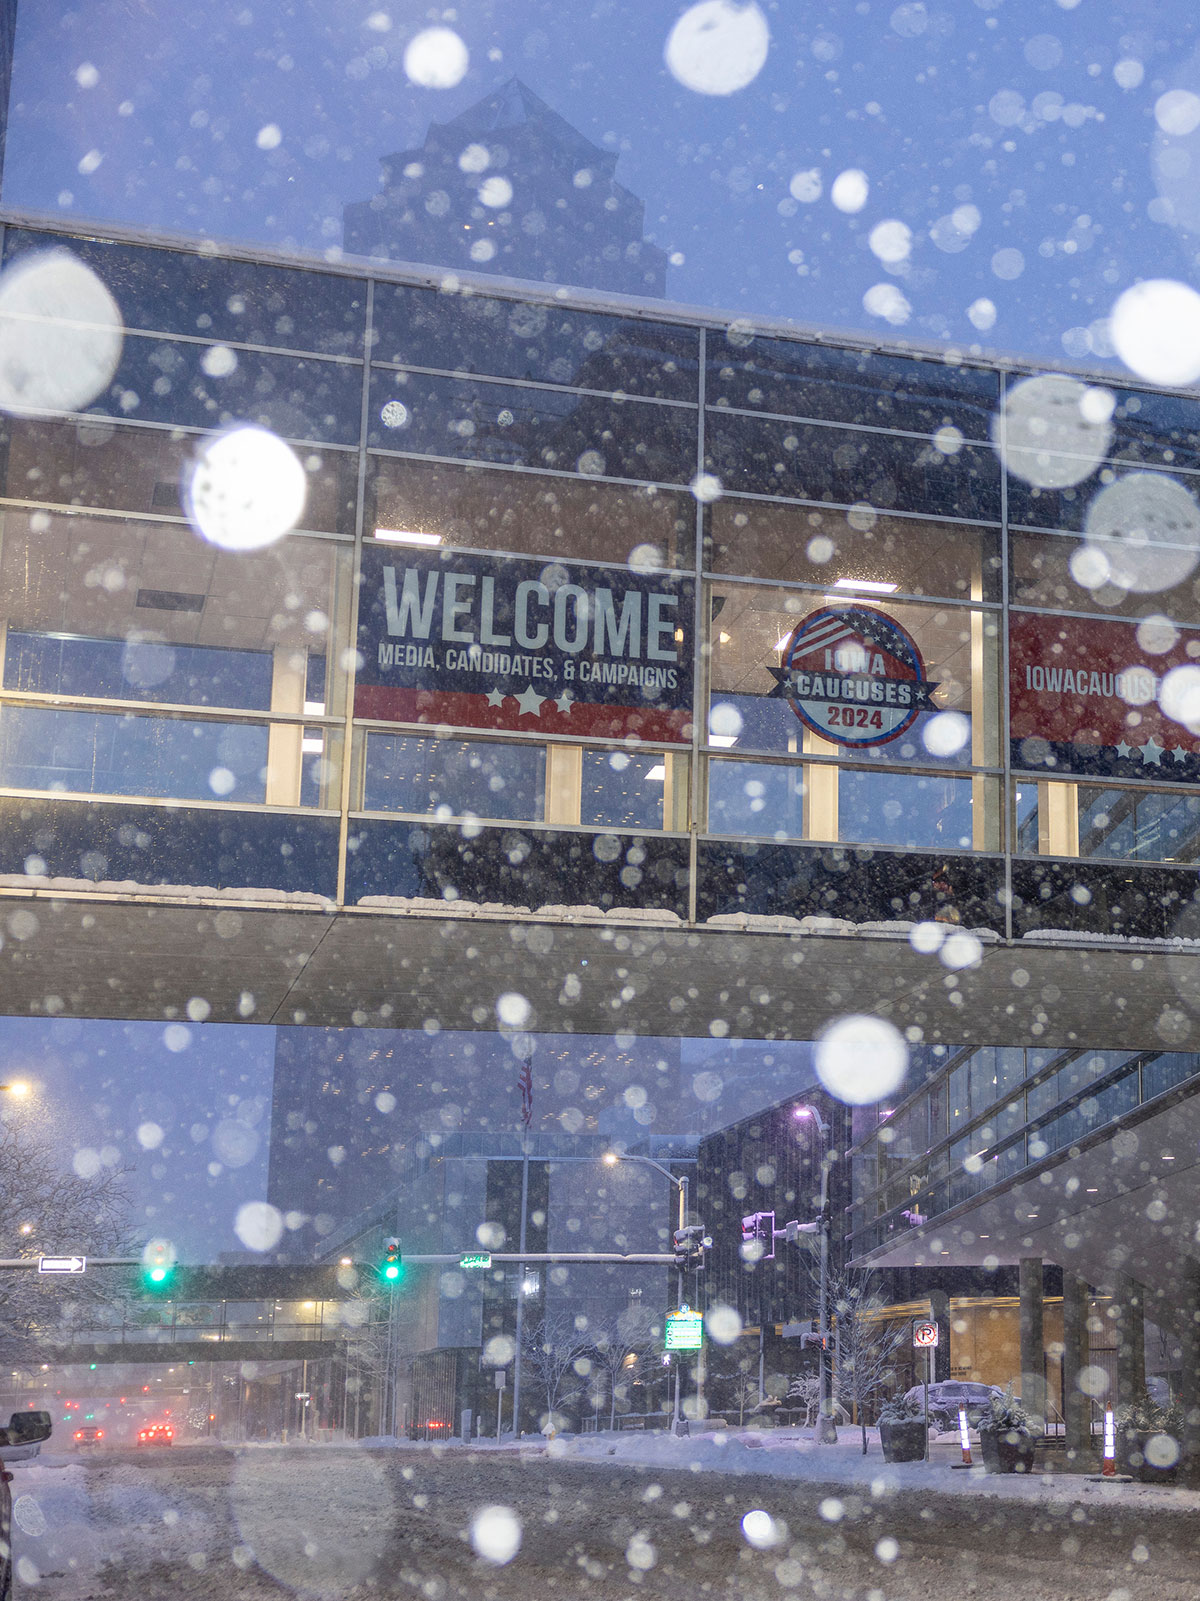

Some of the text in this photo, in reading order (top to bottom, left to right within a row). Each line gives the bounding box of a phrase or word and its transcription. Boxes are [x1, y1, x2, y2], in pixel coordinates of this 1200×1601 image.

[383, 566, 679, 662] WELCOME
[378, 643, 678, 689] MEDIA, CANDIDATES, & CAMPAIGNS
[824, 648, 887, 676] IOWA
[796, 675, 912, 704] CAUCUSES
[827, 706, 883, 729] 2024
